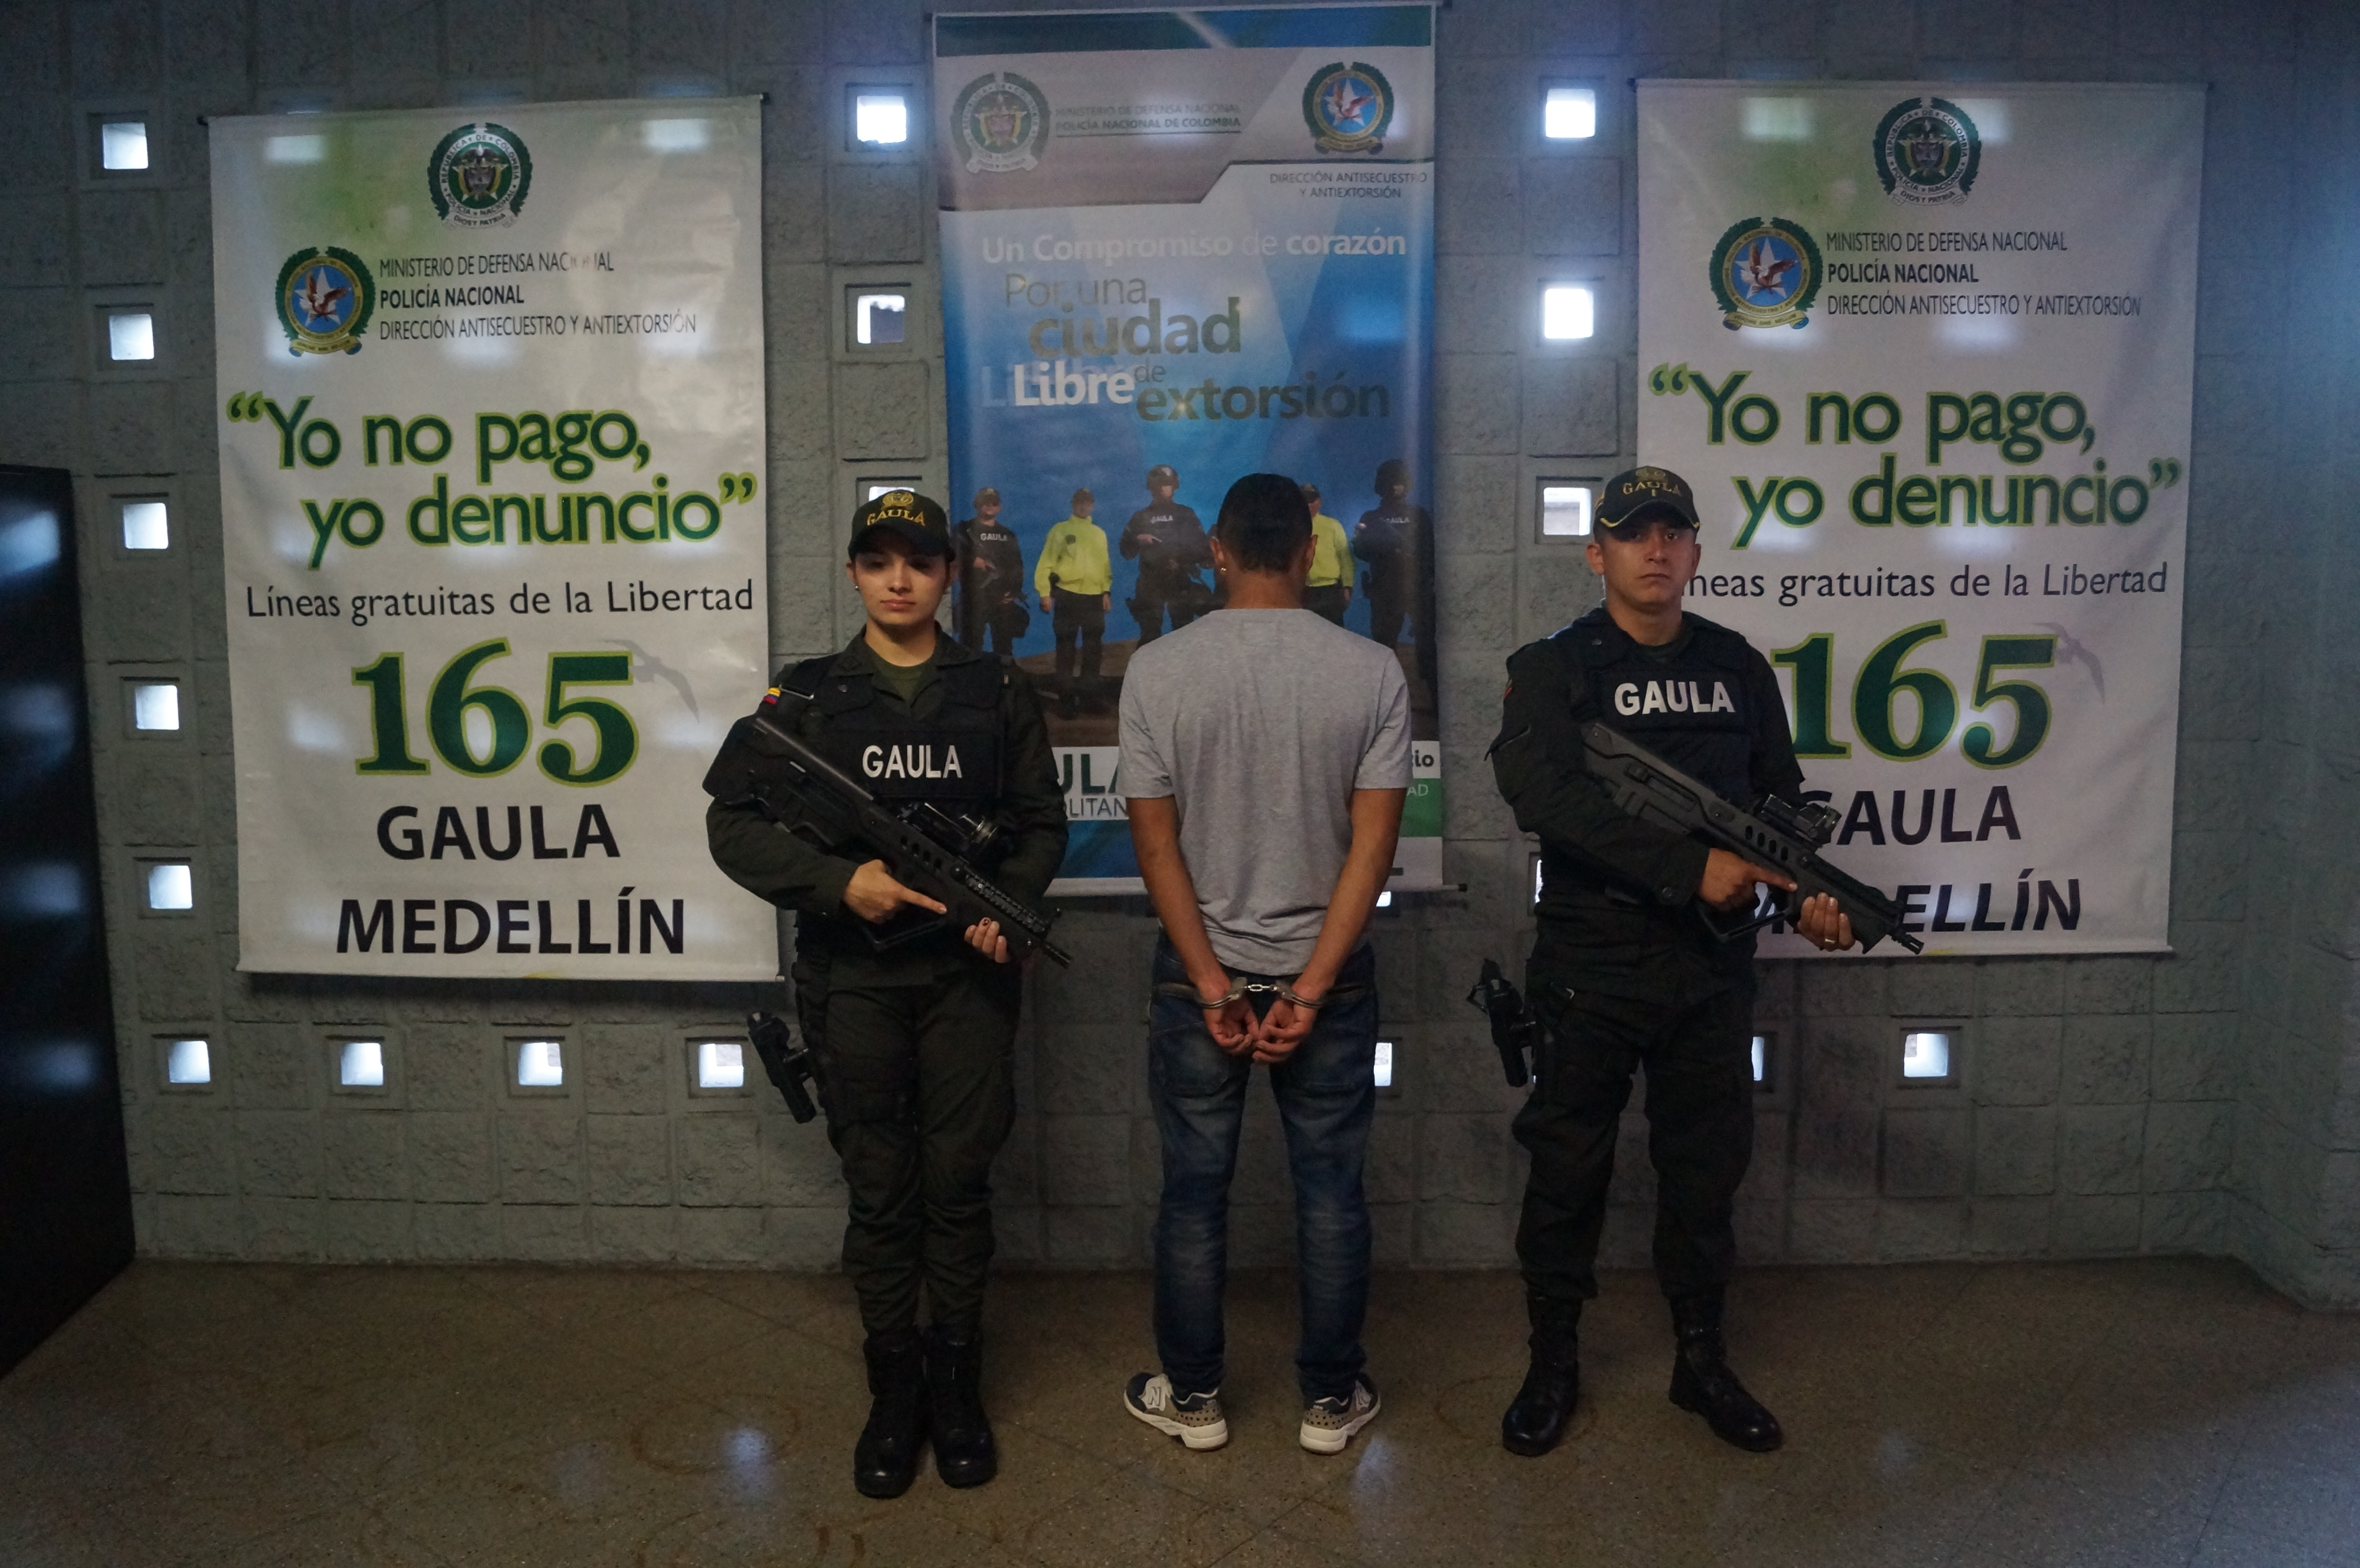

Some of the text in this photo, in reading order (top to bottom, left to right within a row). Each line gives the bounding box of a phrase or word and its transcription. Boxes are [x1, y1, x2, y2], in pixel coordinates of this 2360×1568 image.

[1103, 118, 1161, 130] NACIONAL
[1165, 118, 1179, 128] DE
[1181, 117, 1241, 128] COLOMBIA
[1269, 170, 1427, 184] DIRECCIÓN ANTISECUESTRO
[1309, 185, 1401, 198] ANTIEXTORSIÓN
[982, 227, 1406, 267] Un Compromiso de corazón
[1826, 231, 2068, 252] MINISTERIO DE DEFENSA NACIONAL
[380, 257, 454, 278] MINISTERIO
[458, 255, 475, 276] DE
[479, 253, 535, 274] DEFENSA
[1828, 258, 1979, 283] POLICÍA NACIONAL
[380, 283, 525, 309] POLICÍA NACIONAL
[1005, 272, 1147, 307] Por una
[1827, 290, 2141, 316] DIRECCIÓN ANTISECUESTRO Y ANTIEXTORSIÓN
[380, 308, 696, 340] DIRECCIÓN ANTISECUESTRO Y ANTIEXTORSIÓN
[1029, 296, 1241, 359] ciudad
[1013, 360, 1135, 406] Libre
[1133, 358, 1168, 383] de
[1136, 369, 1390, 422] extorsión
[1647, 362, 2096, 466] “Yo no pago,
[226, 392, 651, 487] “Yo no pago,
[1622, 481, 1682, 497] GAULA
[1730, 453, 2182, 551] yo denuncio”
[300, 472, 758, 571] yo denuncio”
[866, 509, 926, 527] GAULA
[980, 533, 1008, 541] GAULA
[1682, 561, 2168, 607] neas gratuitas de la Libertad
[246, 579, 754, 627] Líneas gratuitas de la Libertad
[1614, 679, 1735, 716] GAULA
[1770, 619, 2058, 769] 165
[351, 637, 639, 788] 165
[862, 745, 962, 779] GAULA
[376, 804, 621, 861] GAULA
[336, 885, 685, 954] MEDELLÍN
[1147, 1386, 1161, 1407] N
